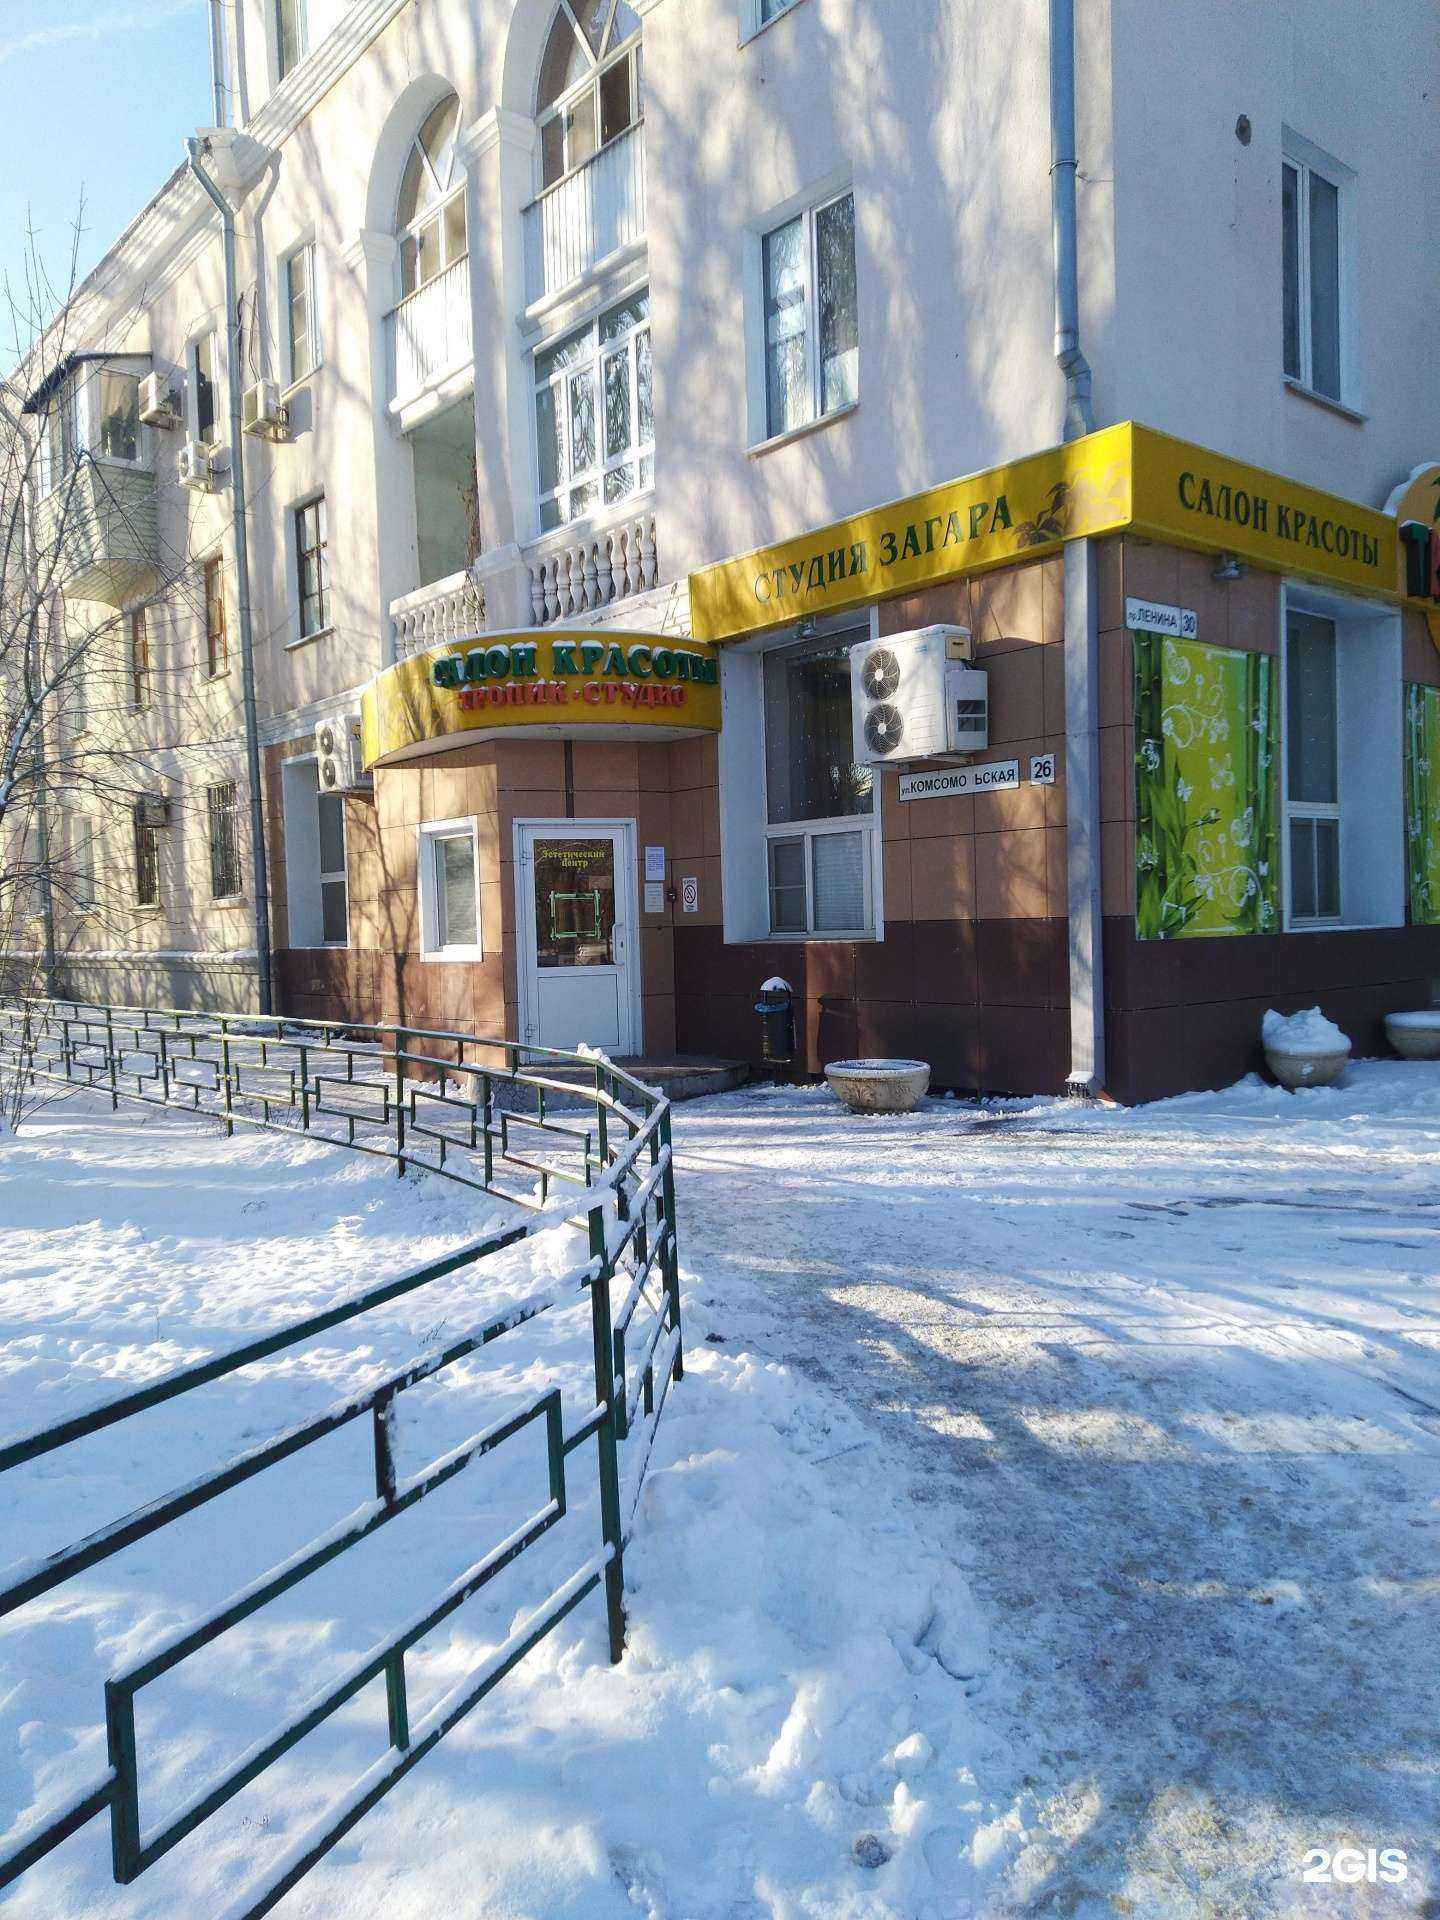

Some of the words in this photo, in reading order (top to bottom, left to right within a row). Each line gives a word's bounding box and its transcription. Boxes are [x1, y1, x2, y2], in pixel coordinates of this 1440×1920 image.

[753, 540, 867, 603] СТУДИЯ
[878, 494, 1013, 567] ЗАГАРА
[1178, 471, 1268, 533] САЛОН
[1276, 503, 1379, 567] КРАСОТЫ
[551, 639, 718, 685] КРАСОТЫ
[1034, 760, 1052, 779] 26
